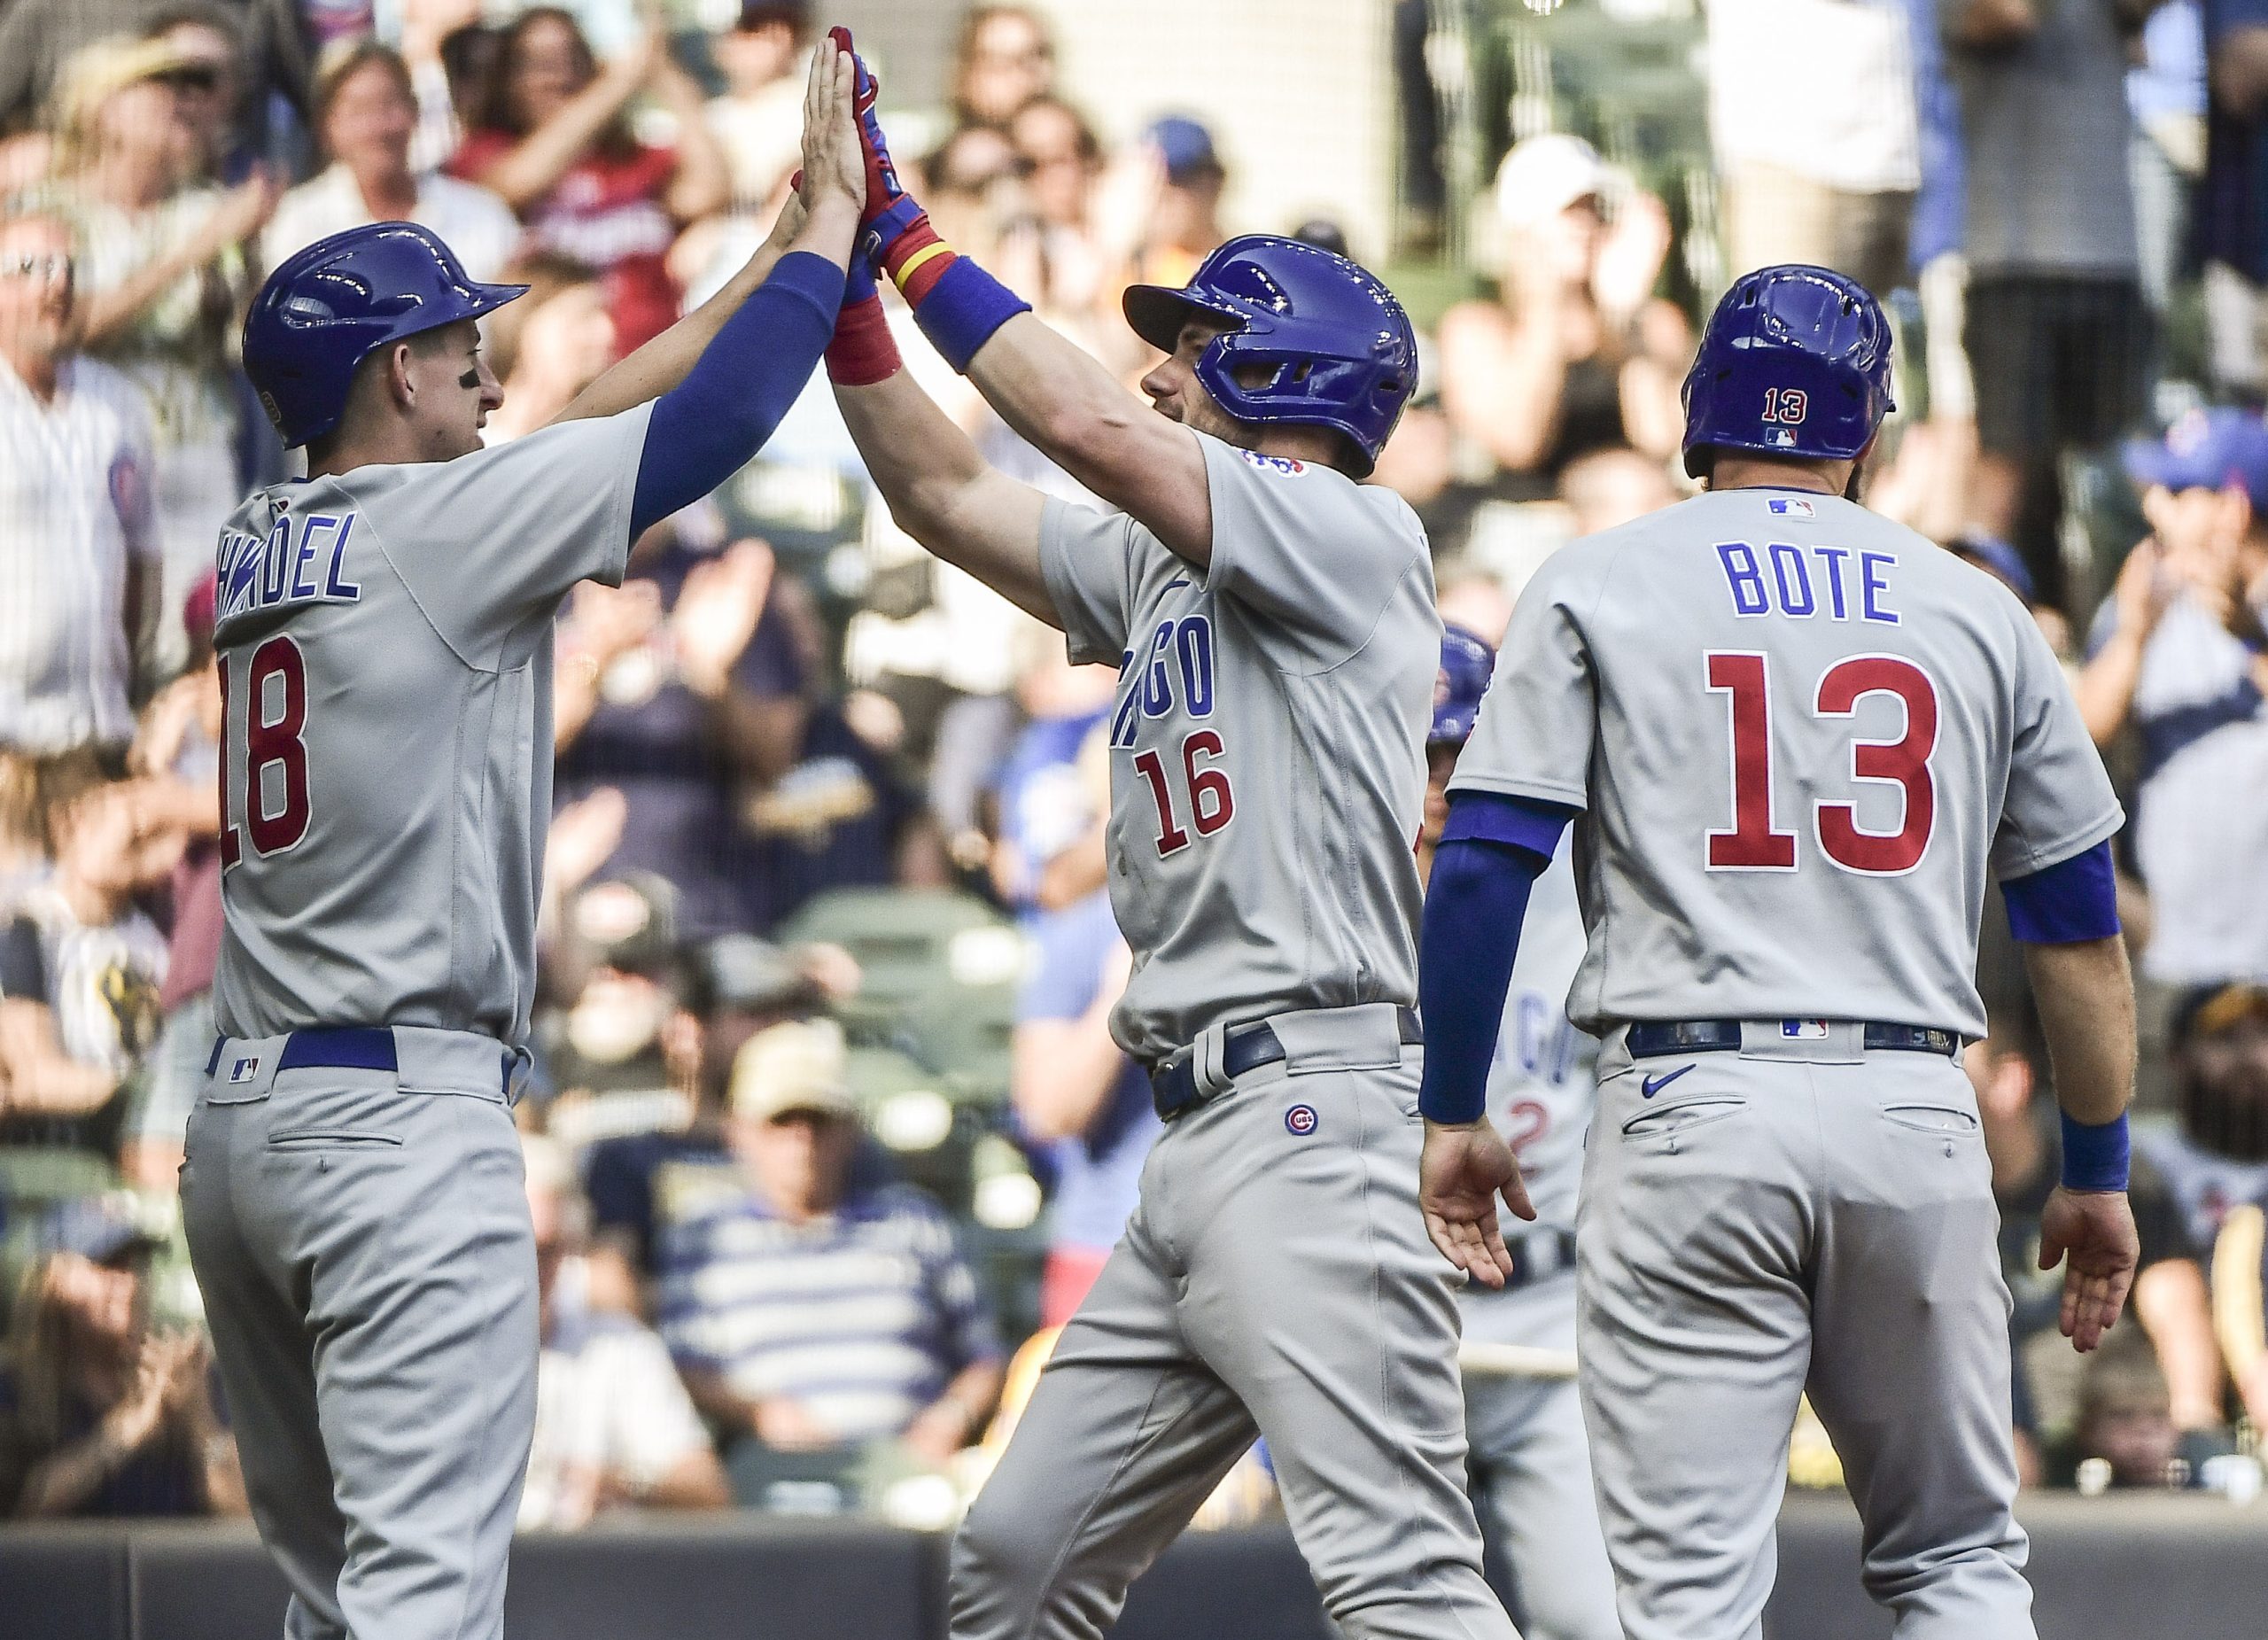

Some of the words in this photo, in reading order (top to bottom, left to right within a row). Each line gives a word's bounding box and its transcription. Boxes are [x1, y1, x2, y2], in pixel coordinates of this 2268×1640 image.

[1761, 387, 1808, 424] 13
[1713, 540, 1902, 627] BOTE
[1132, 727, 1237, 859] 16
[1703, 649, 1942, 877] 13
[1289, 1108, 1314, 1131] CUBS
